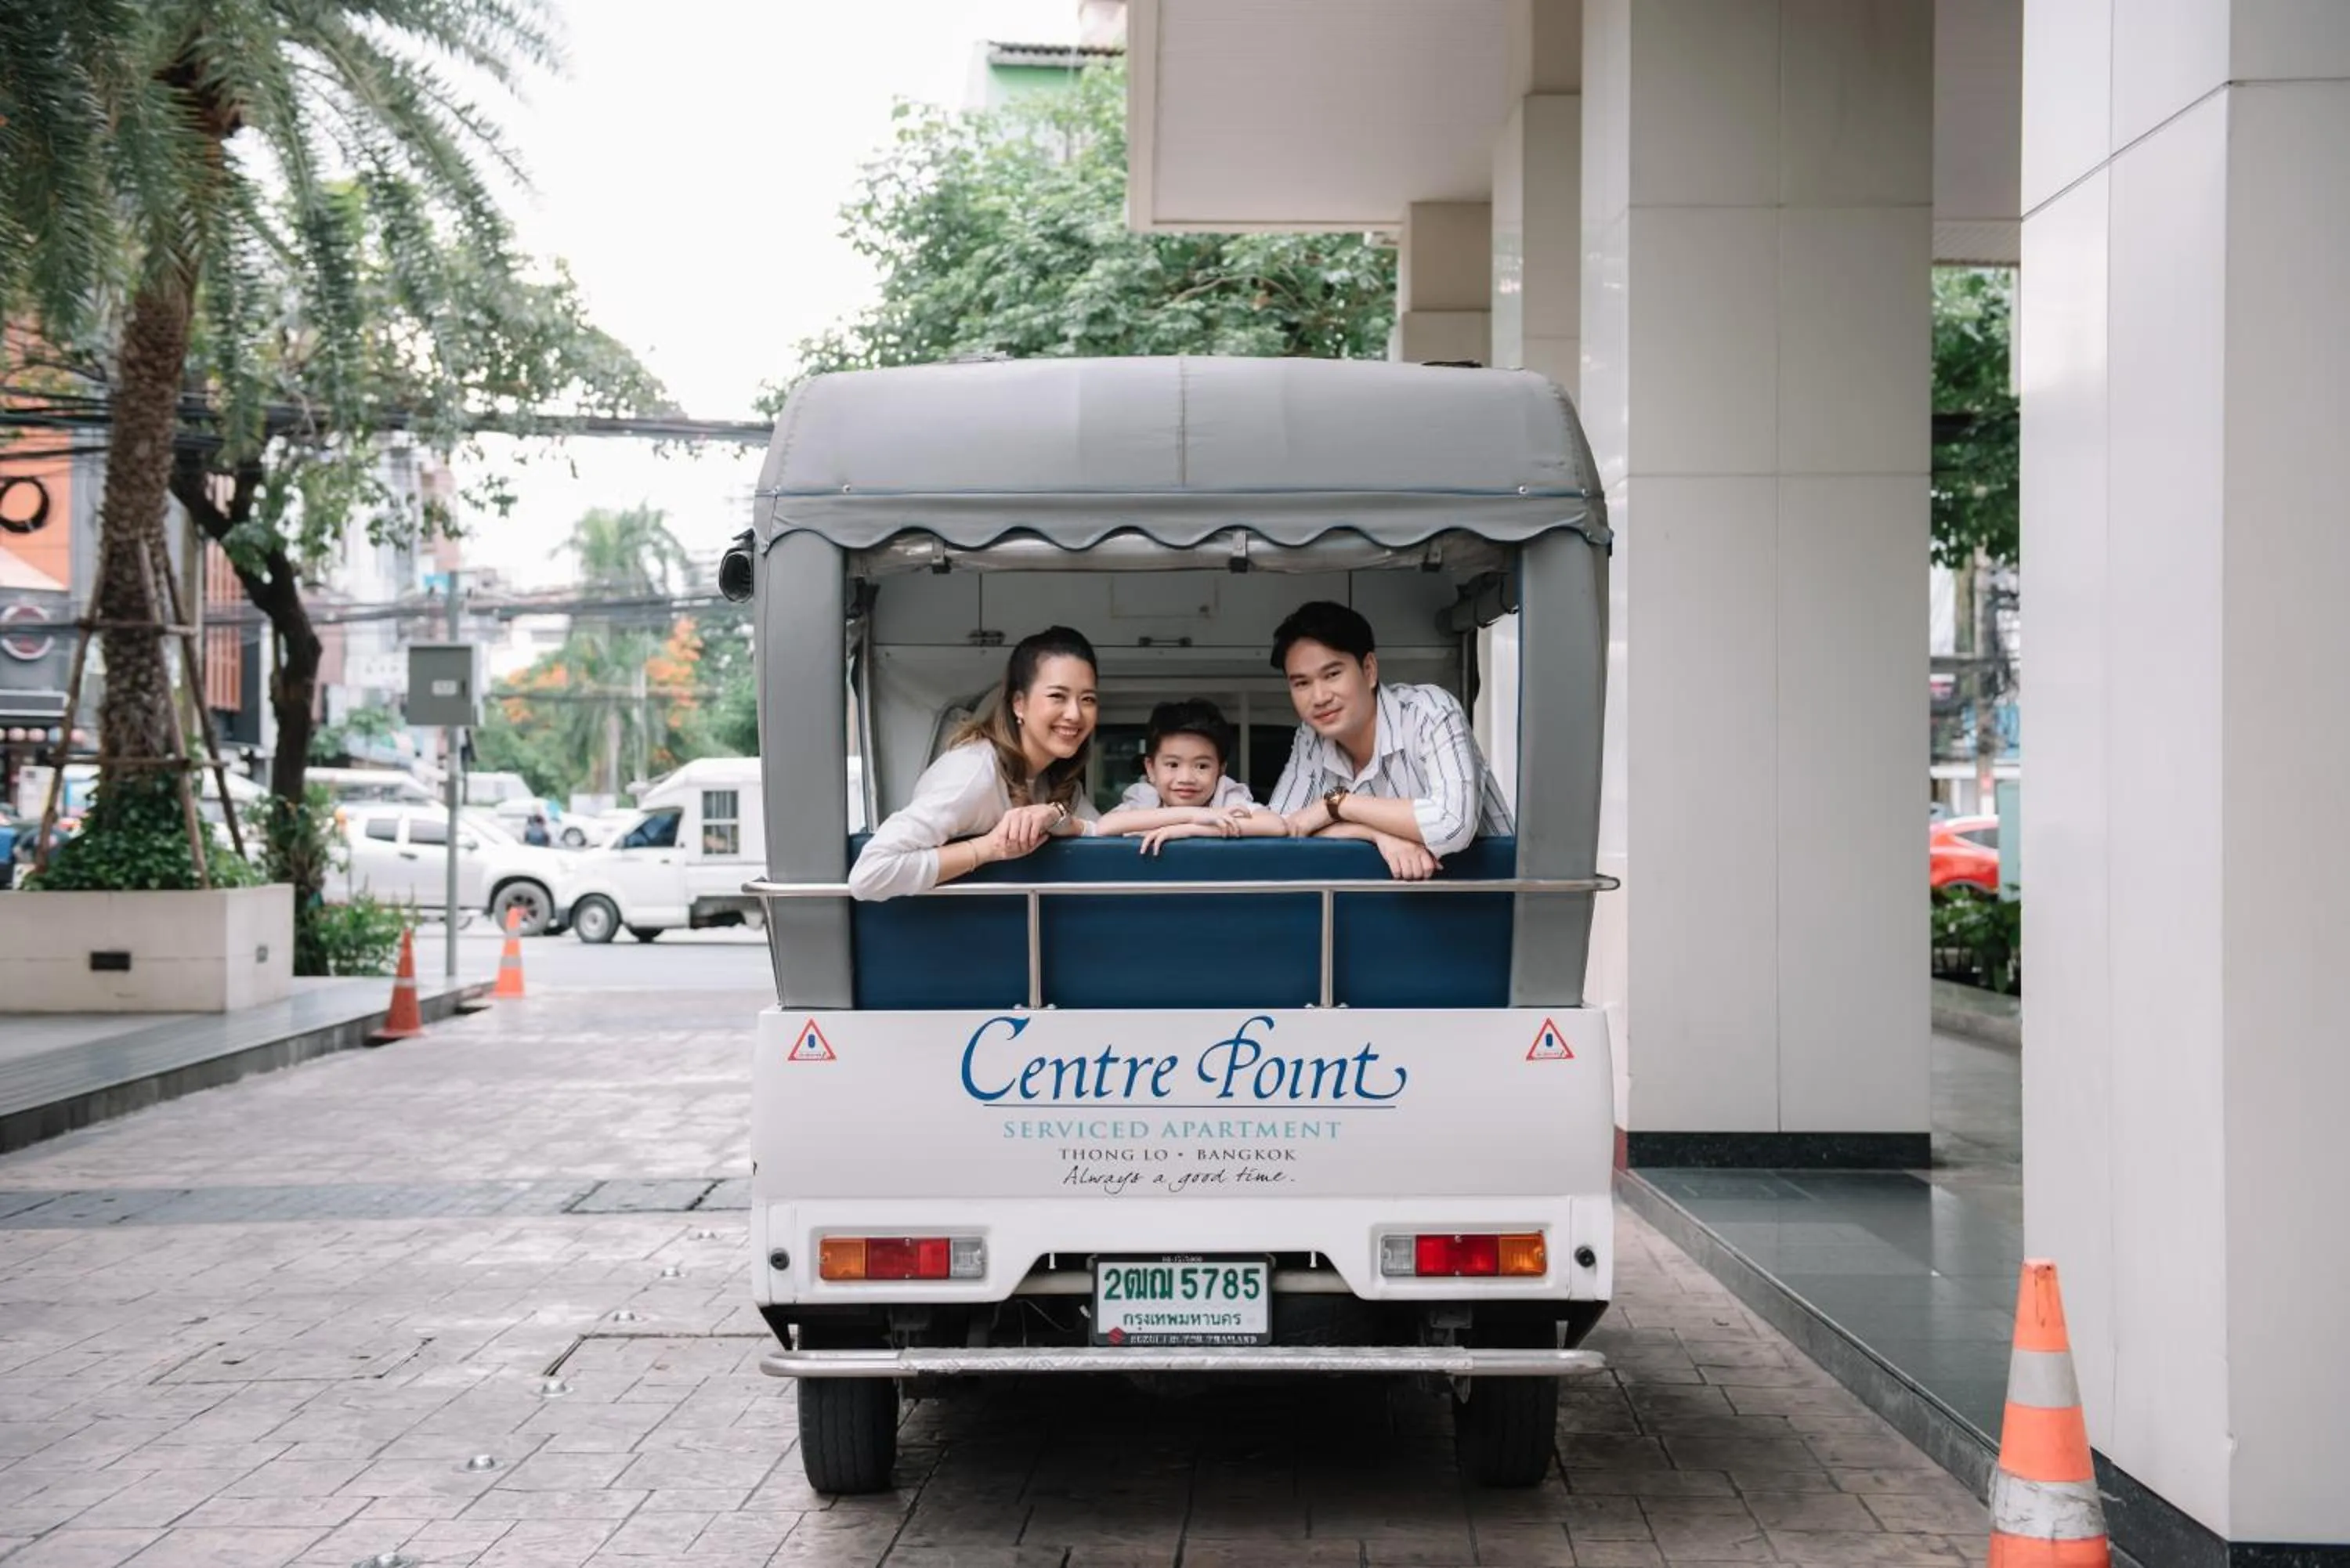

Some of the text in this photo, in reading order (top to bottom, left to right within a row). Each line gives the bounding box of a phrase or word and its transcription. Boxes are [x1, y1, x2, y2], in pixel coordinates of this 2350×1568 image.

[960, 1015, 1408, 1100] Centre Point
[1003, 1120, 1343, 1140] SERVICED APARTMENT
[1058, 1148, 1297, 1162] THONG LO BANGKOK
[1062, 1165, 1141, 1195] Always
[1152, 1173, 1165, 1184] a
[1168, 1167, 1227, 1193] good
[1180, 1267, 1260, 1300] 5785
[1123, 1313, 1242, 1331] กรุงเทพมหานคร
